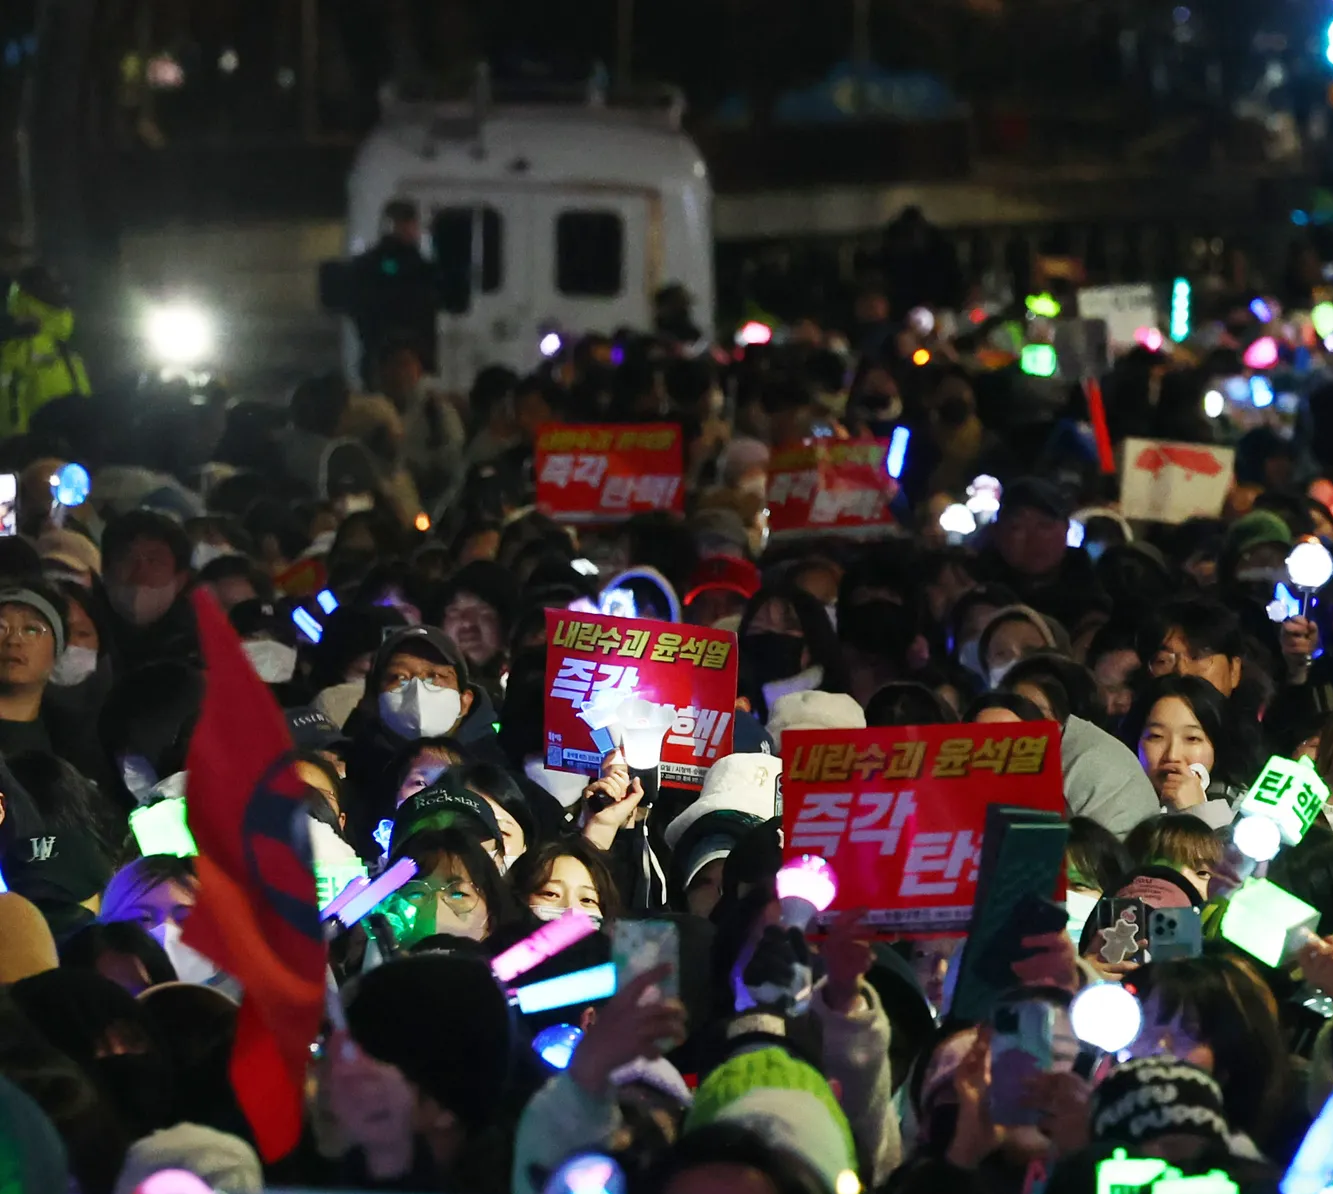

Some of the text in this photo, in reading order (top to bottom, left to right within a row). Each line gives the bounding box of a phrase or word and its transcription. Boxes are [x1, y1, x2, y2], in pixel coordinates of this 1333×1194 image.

[553, 620, 732, 670] 내란수괴 윤석열
[789, 735, 1049, 782] 내란수괴 윤석열
[790, 790, 918, 857] 즉각
[1253, 769, 1322, 839] 탄핵
[898, 830, 984, 897] 탄
